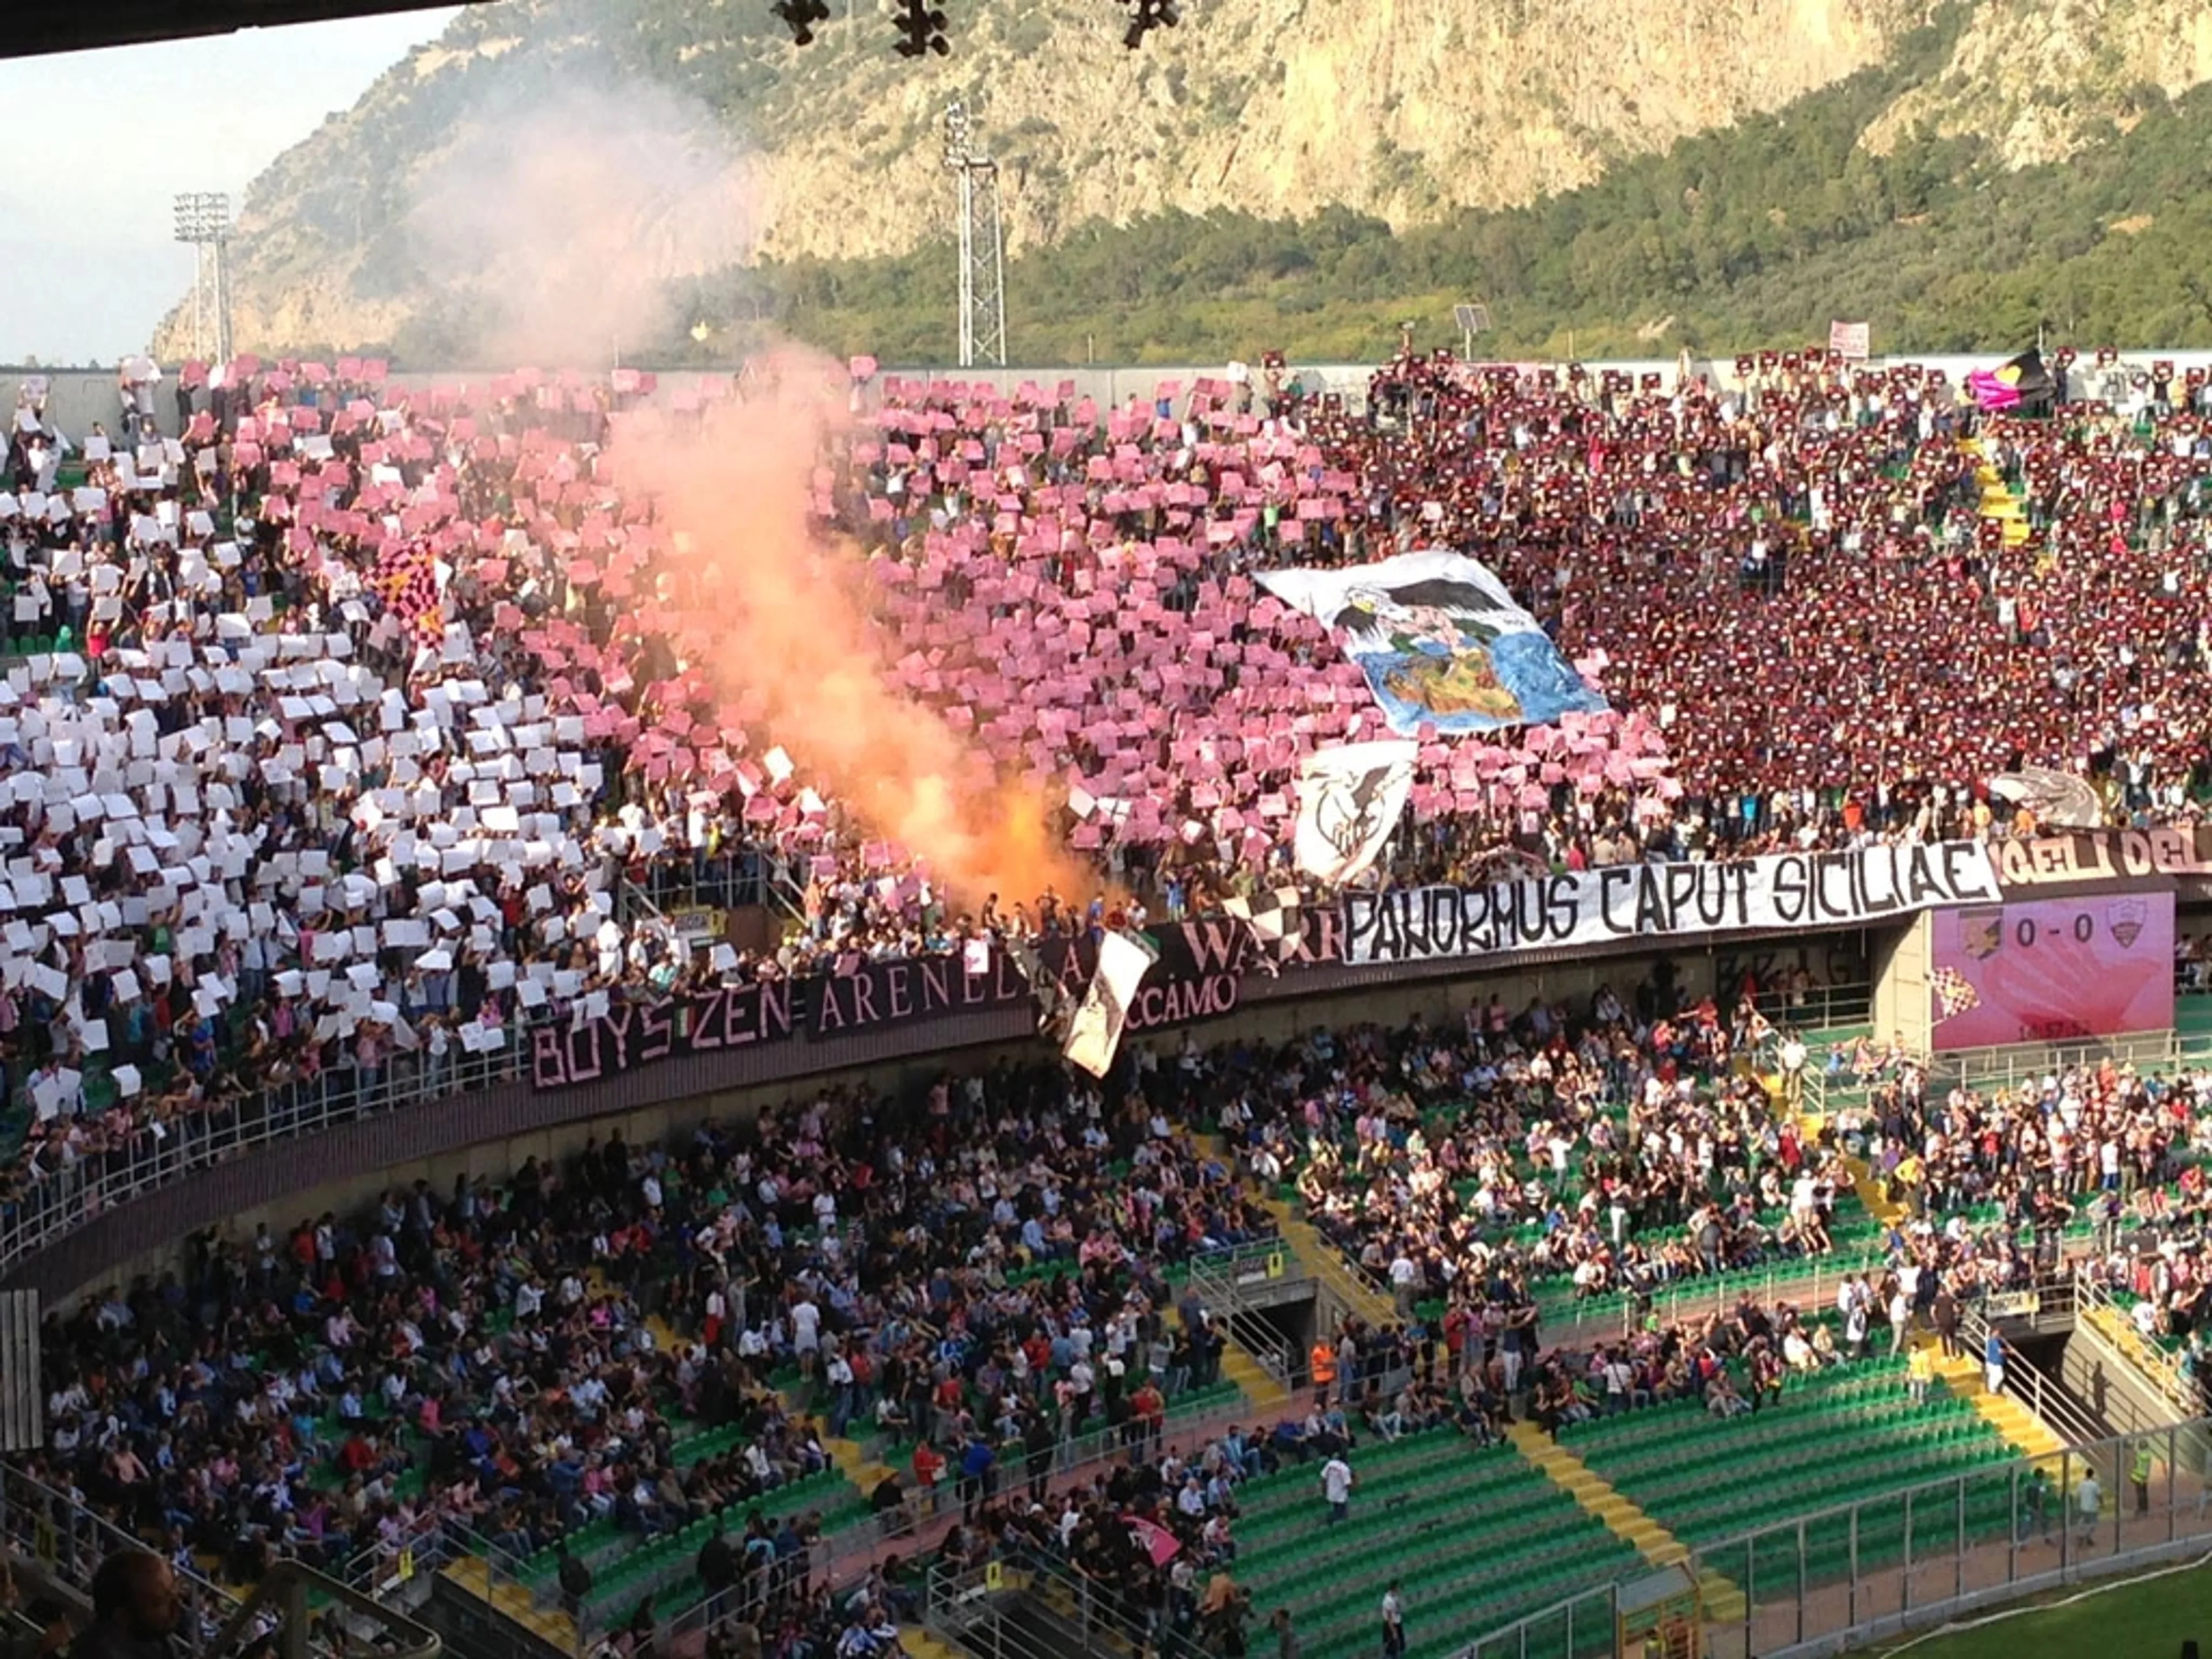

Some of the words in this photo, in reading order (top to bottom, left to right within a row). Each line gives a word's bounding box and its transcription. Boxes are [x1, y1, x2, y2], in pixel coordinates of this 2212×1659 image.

[1343, 875, 1578, 961] PANORMUS
[1601, 861, 1758, 934] CAPUT
[1773, 842, 1990, 922] SICILIAE
[2017, 918, 2035, 947] 0
[2075, 913, 2093, 943] 0
[533, 994, 675, 1088] BOYS
[692, 980, 791, 1049] ZEN
[819, 942, 1090, 1032] ARENELA
